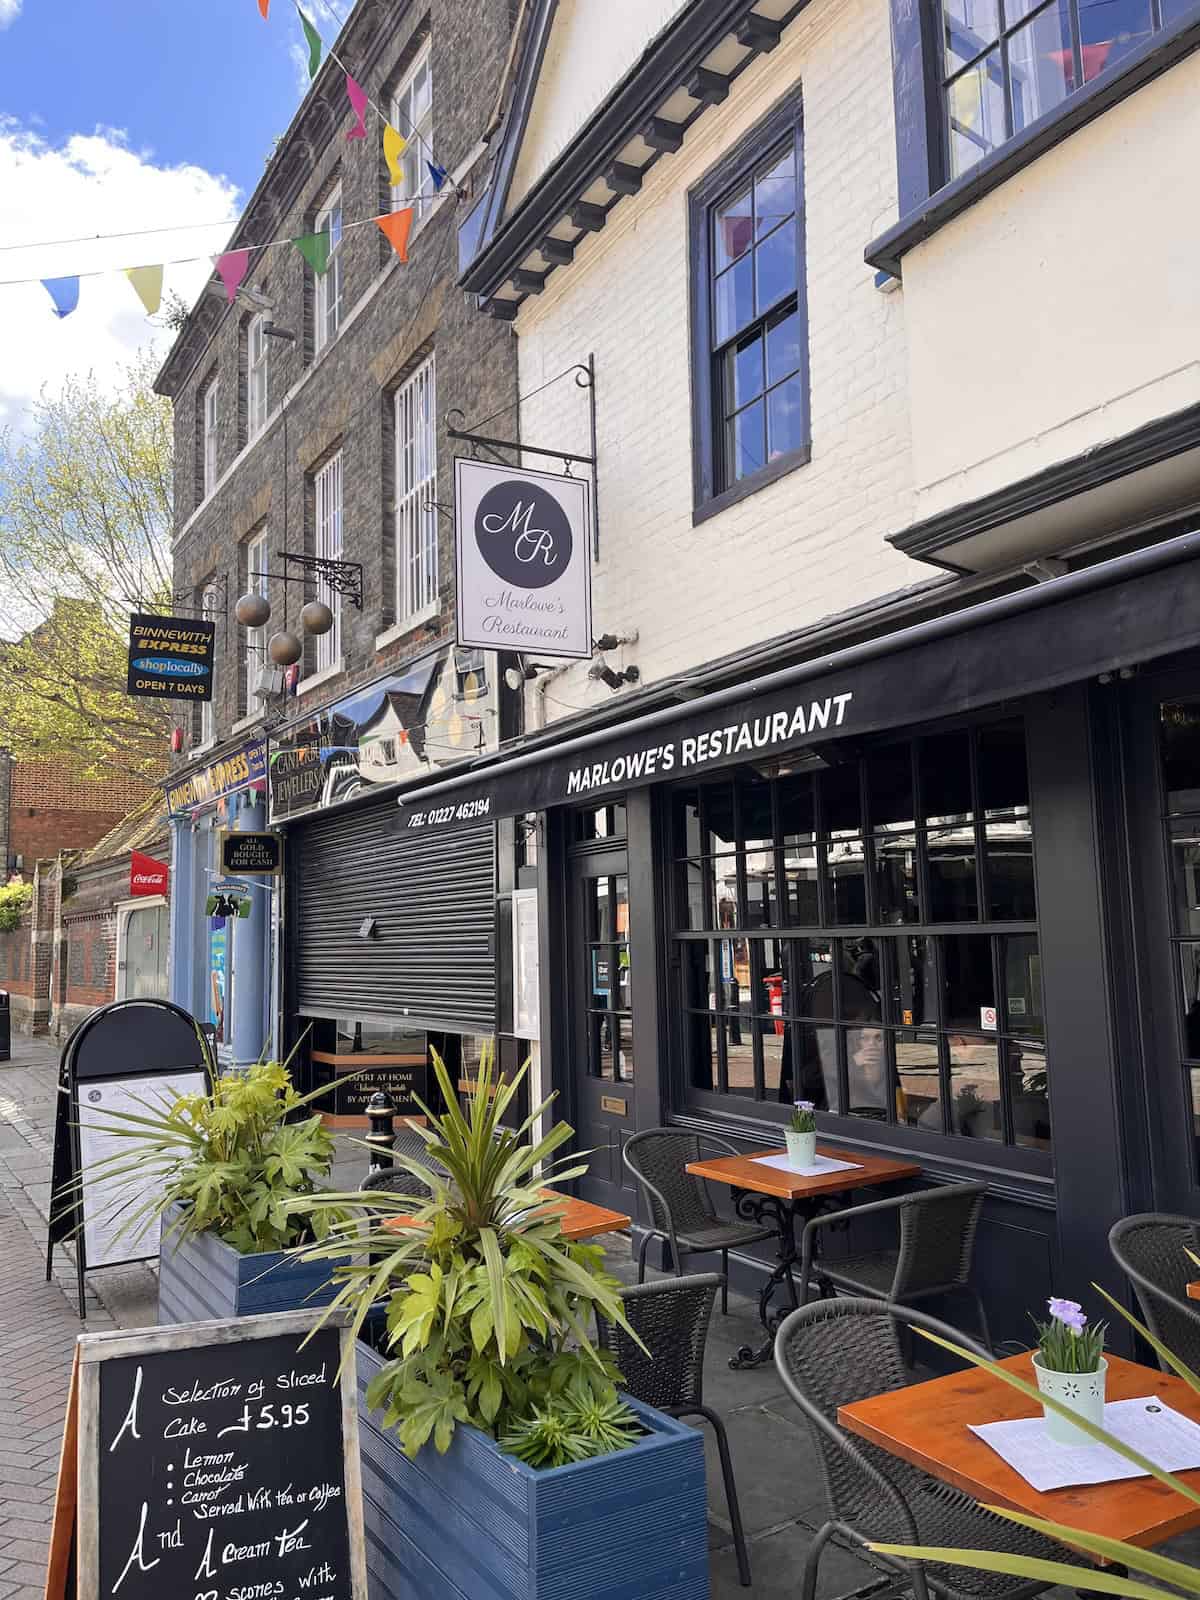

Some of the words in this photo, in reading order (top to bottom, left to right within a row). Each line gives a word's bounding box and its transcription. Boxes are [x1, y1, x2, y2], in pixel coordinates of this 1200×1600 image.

[482, 591, 566, 614] Marlowe's
[133, 626, 212, 643] BINNEWITH
[481, 615, 569, 640] Restaurant
[138, 639, 207, 655] EXPRESS
[136, 679, 166, 690] OPEN
[168, 683, 175, 692] 7
[177, 683, 205, 694] DAYS
[566, 742, 674, 795] MARLOWE'S
[682, 692, 853, 767] RESTAURANT
[407, 812, 427, 828] TEL:
[428, 806, 456, 825] 01227
[456, 797, 491, 820] 462194
[239, 843, 265, 851] GOLD
[250, 858, 273, 866] CASH
[376, 1073, 387, 1081] AT
[388, 1072, 413, 1081] HOME
[347, 1095, 357, 1104] BY
[110, 1366, 142, 1451] A
[245, 1379, 265, 1401] of
[163, 1416, 208, 1439] Cake
[184, 1448, 235, 1469] Lemon
[296, 1492, 307, 1503] or
